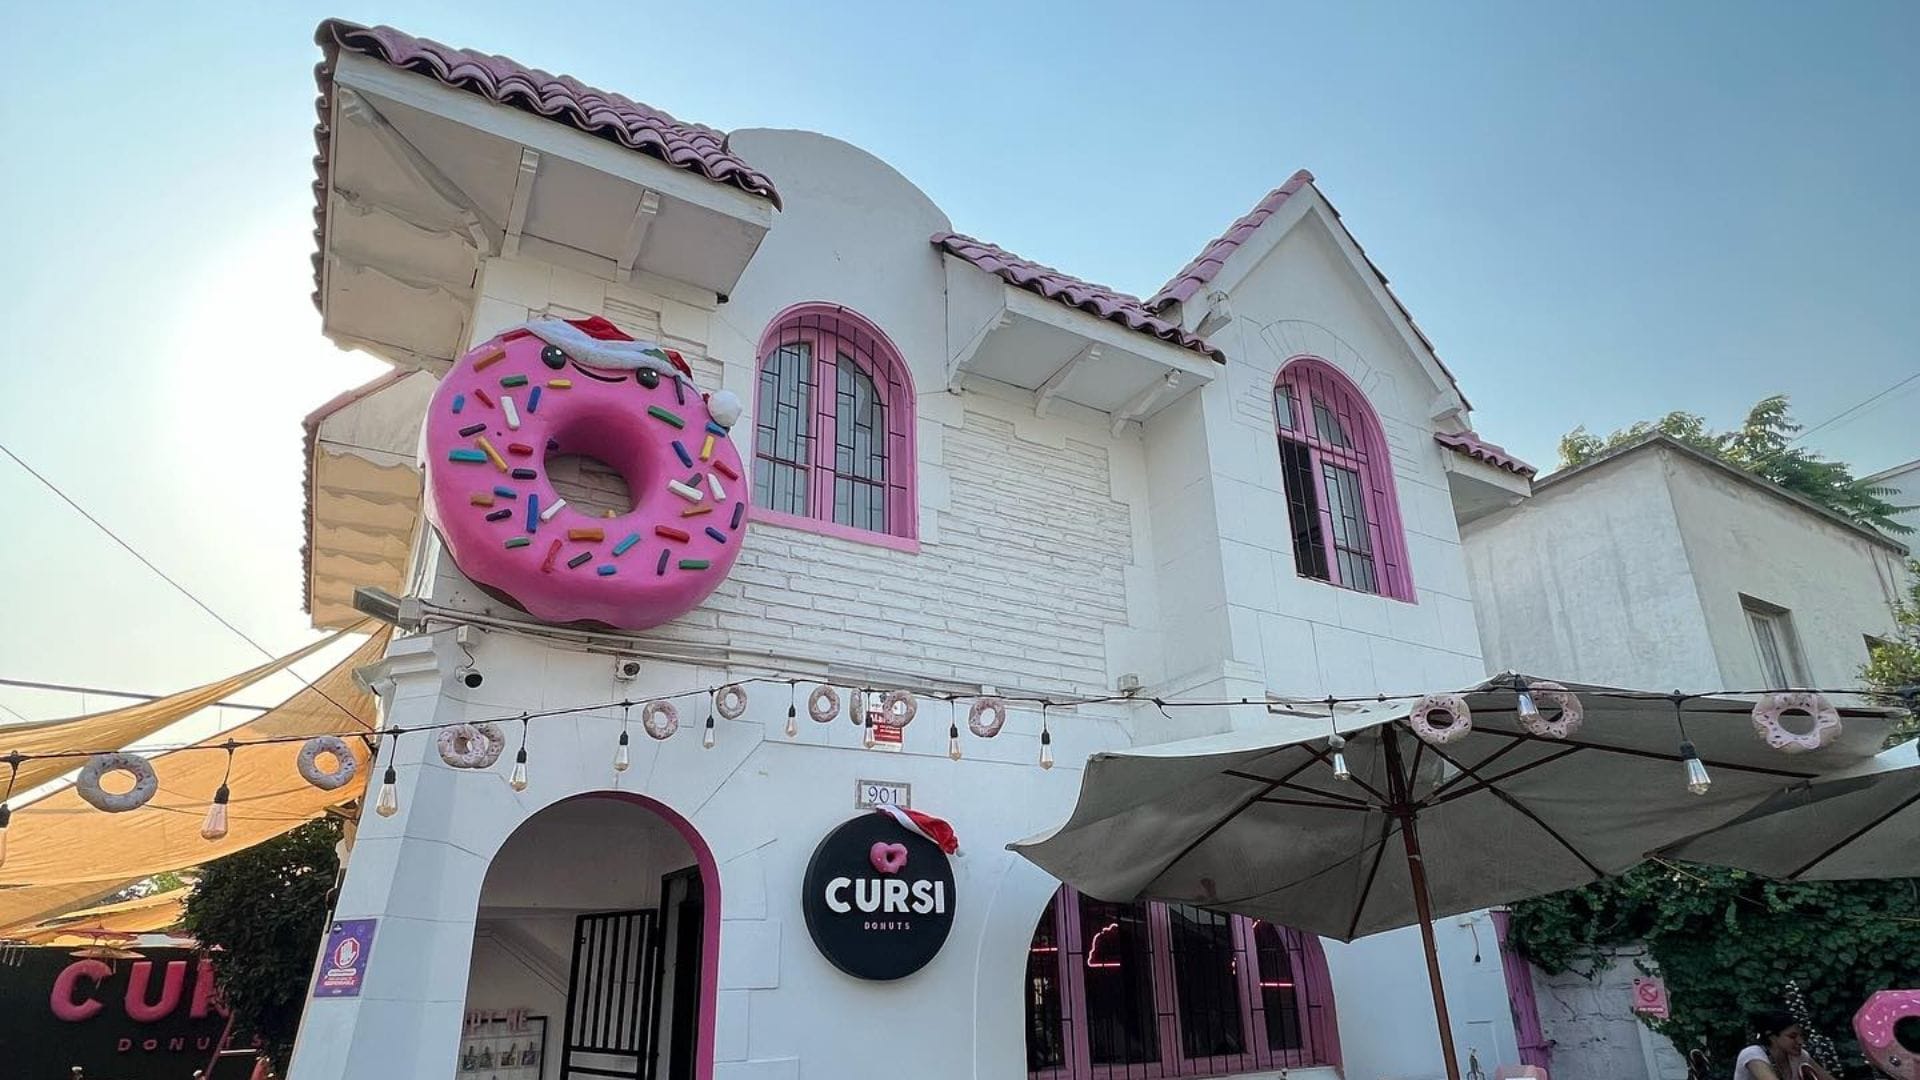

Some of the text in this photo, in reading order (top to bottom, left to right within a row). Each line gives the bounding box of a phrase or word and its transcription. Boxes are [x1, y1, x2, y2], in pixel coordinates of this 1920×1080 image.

[867, 786, 899, 803] 901
[825, 877, 945, 914] CURSI
[864, 922, 911, 930] DONUTS
